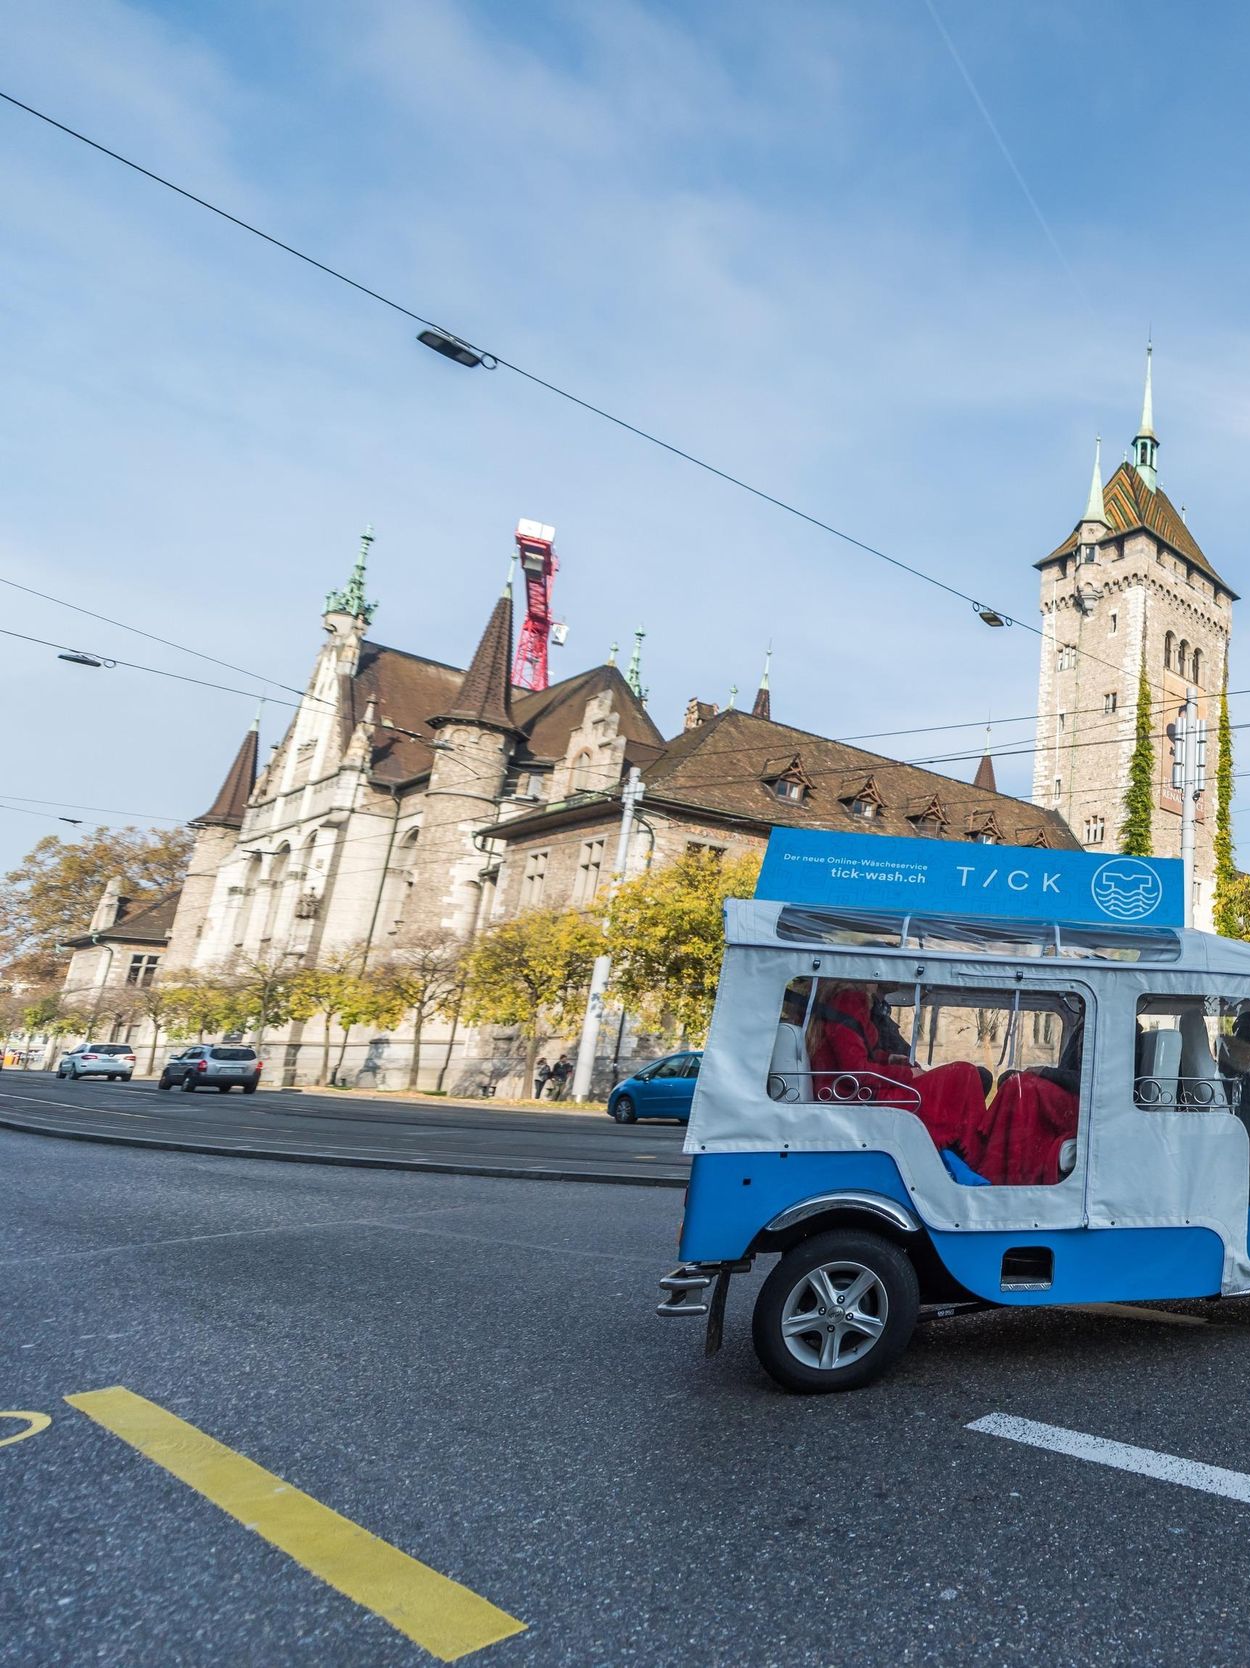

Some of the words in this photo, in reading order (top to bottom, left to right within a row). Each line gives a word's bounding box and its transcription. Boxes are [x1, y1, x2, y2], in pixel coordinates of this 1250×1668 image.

[783, 853, 800, 861] Der
[827, 856, 928, 871] Online-Wäscheservice
[831, 867, 926, 884] tick-wash.ch
